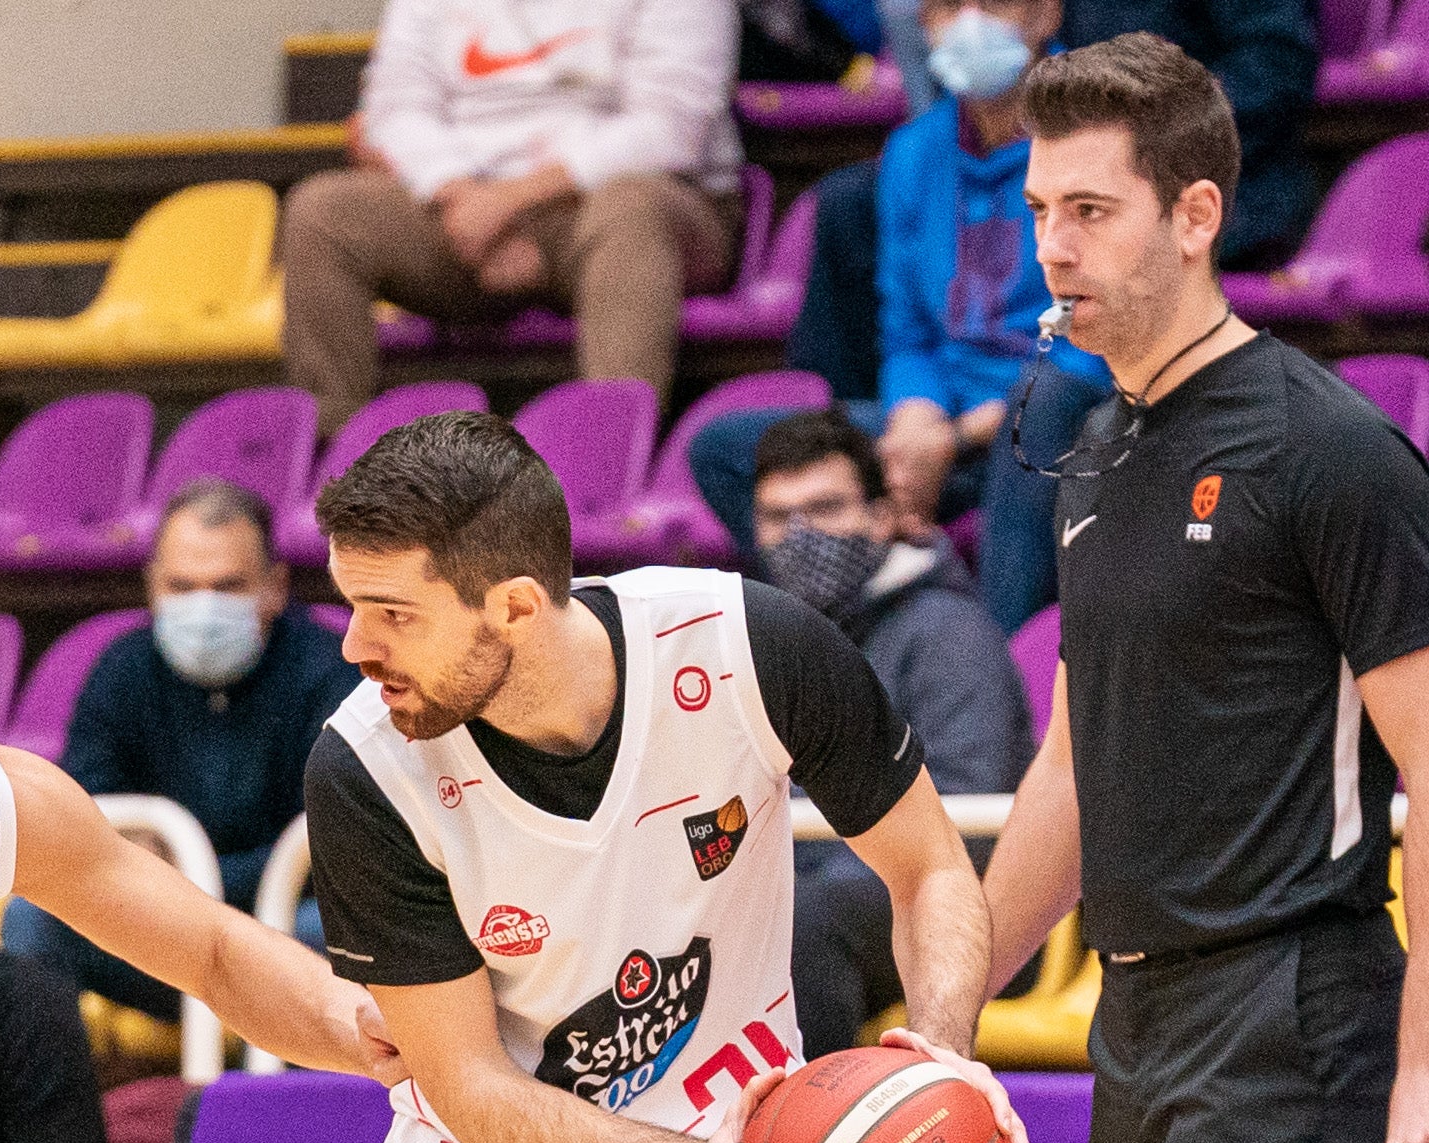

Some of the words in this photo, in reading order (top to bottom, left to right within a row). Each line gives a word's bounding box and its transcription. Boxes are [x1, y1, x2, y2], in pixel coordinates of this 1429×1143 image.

[1186, 523, 1212, 541] FEB
[688, 823, 713, 840] Liga
[694, 834, 732, 864] LEB
[700, 852, 733, 876] ORO
